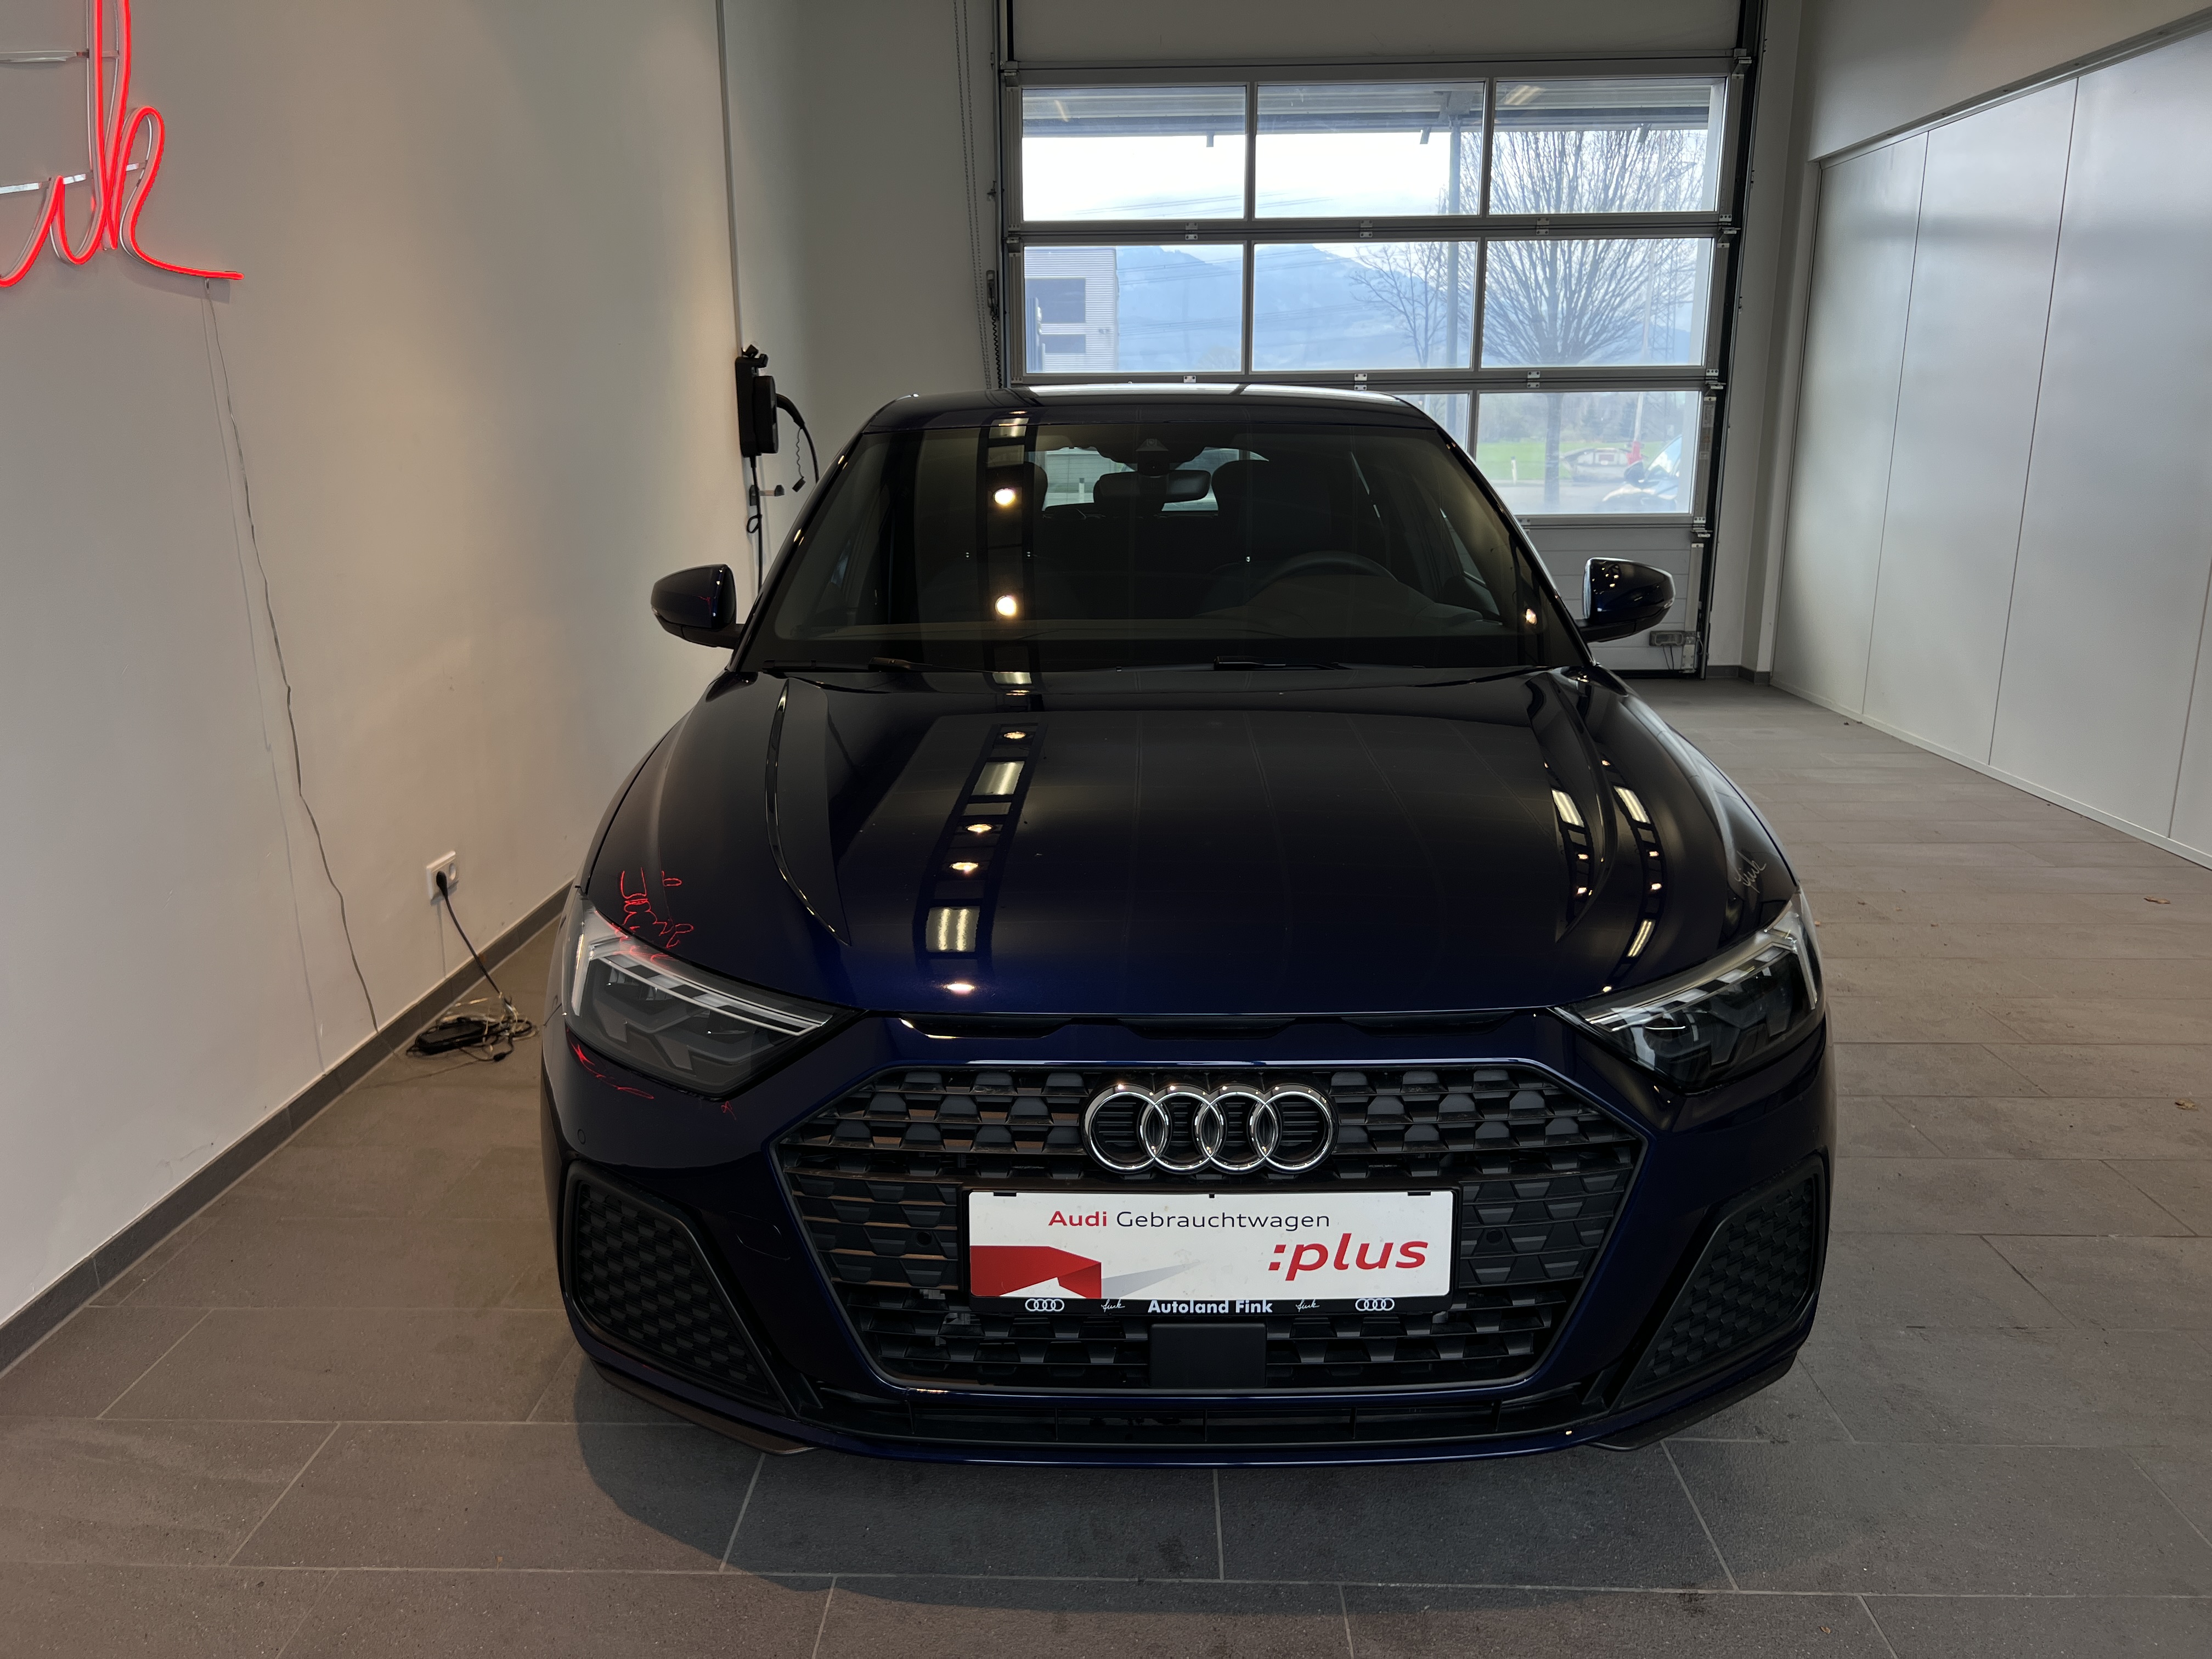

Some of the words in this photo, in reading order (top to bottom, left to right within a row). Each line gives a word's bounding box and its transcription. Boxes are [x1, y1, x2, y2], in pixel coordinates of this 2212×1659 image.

[1048, 1210, 1107, 1227] Audi
[1116, 1211, 1330, 1232] Gebrauchtwagen
[1148, 1300, 1229, 1314] Autoland
[1235, 1300, 1273, 1313] Fink
